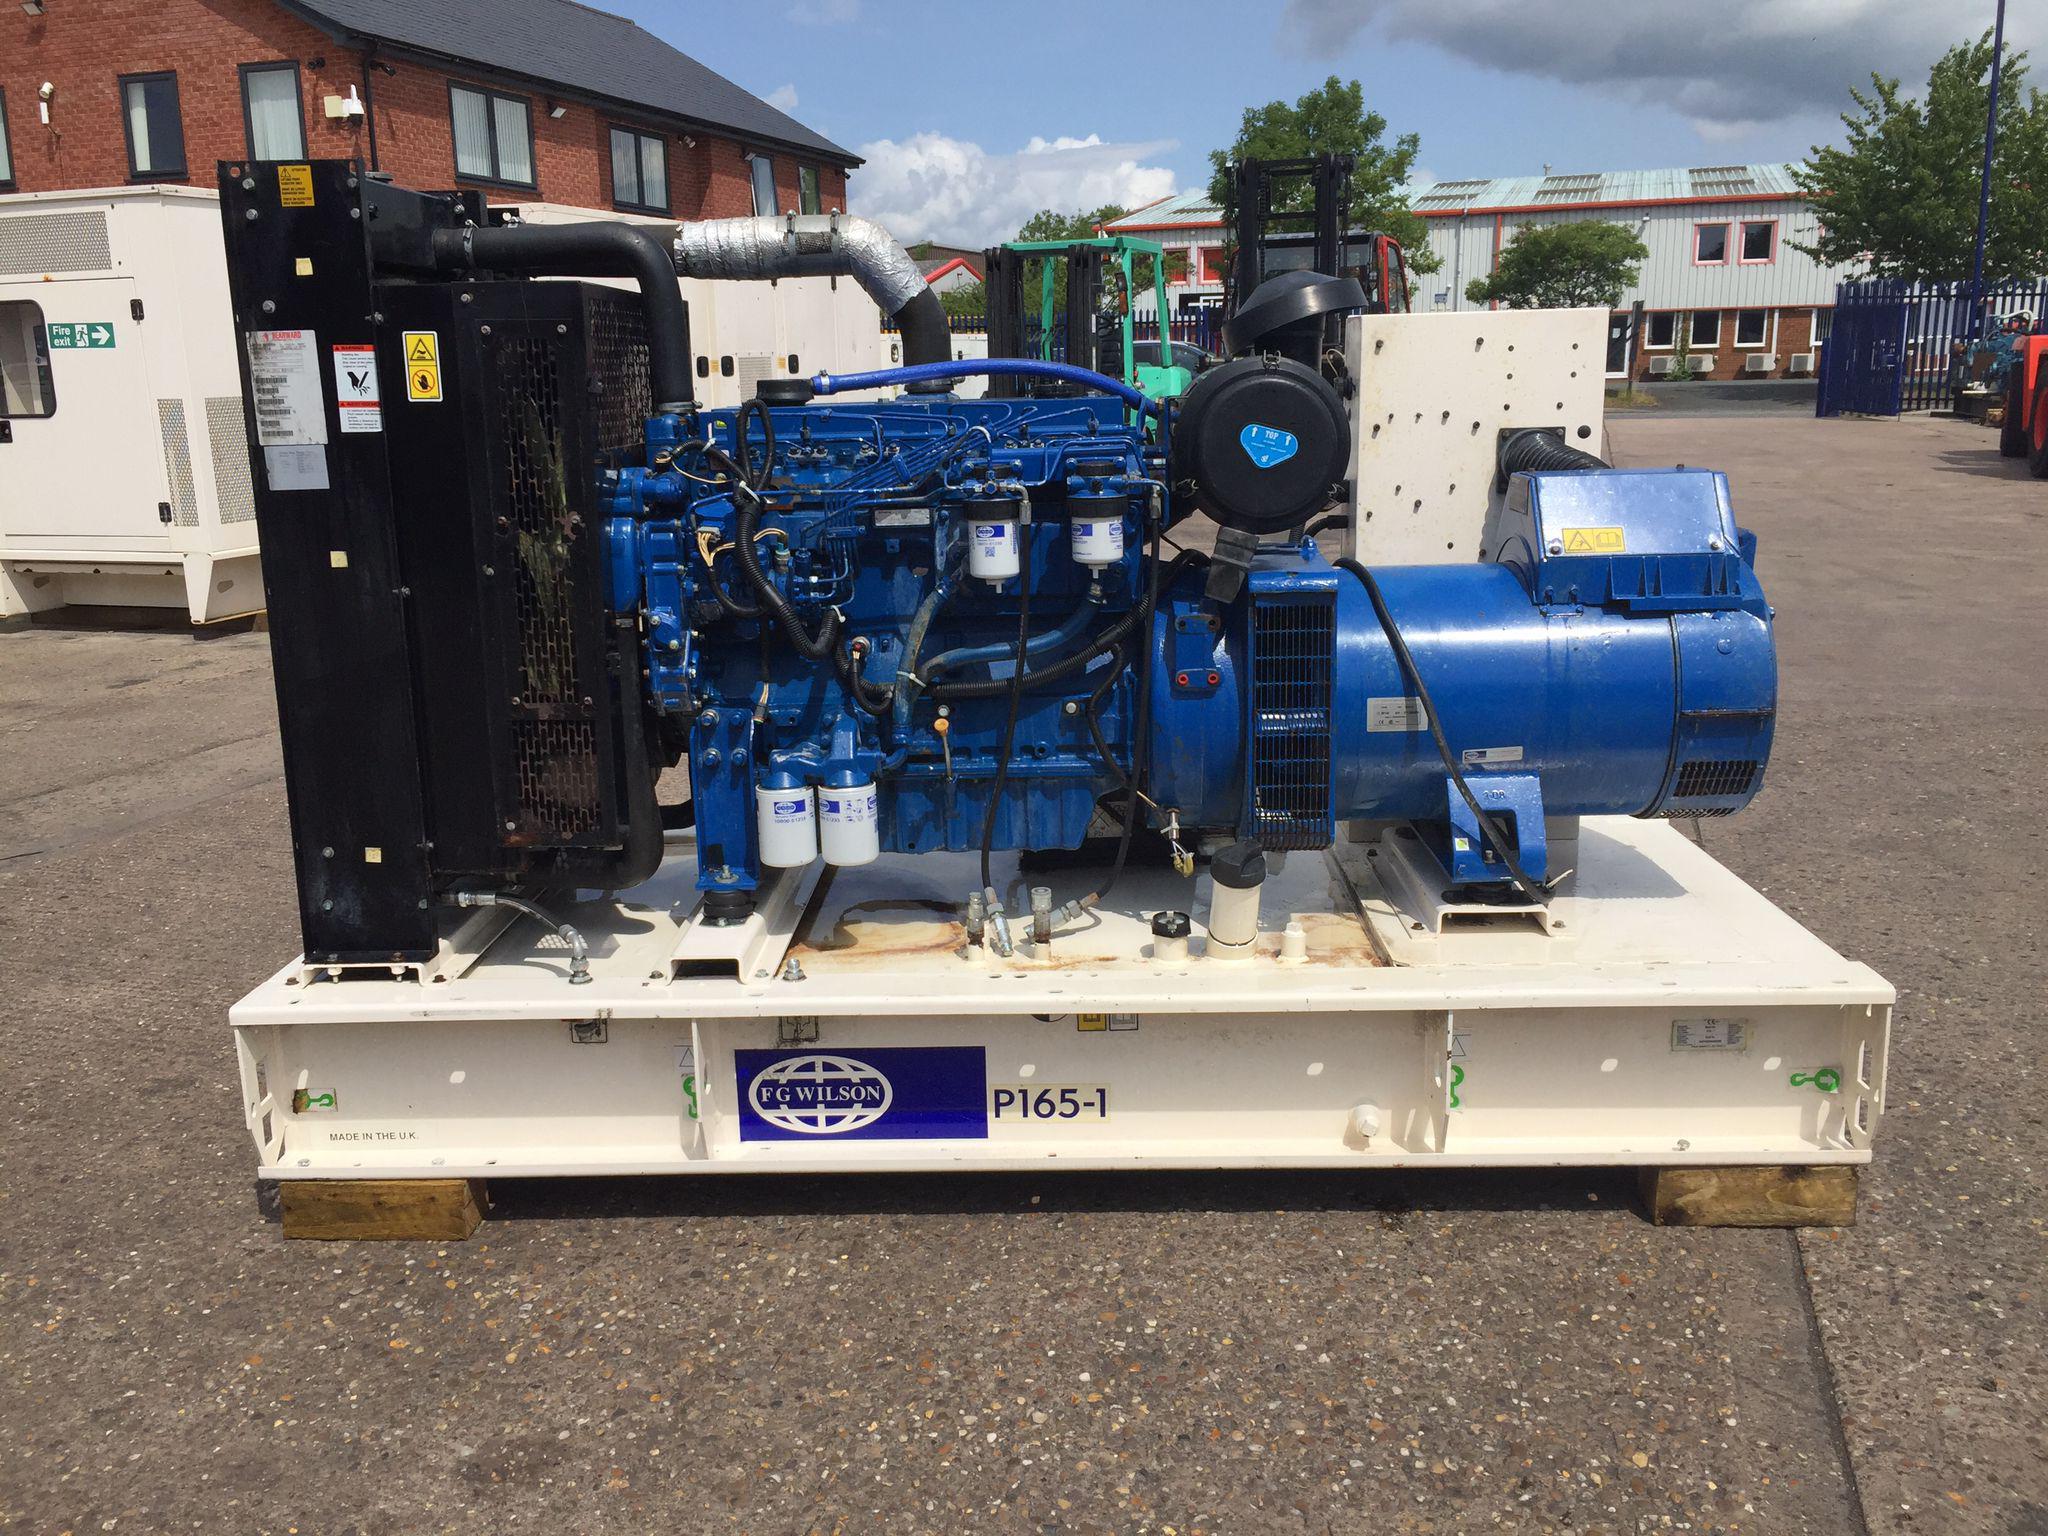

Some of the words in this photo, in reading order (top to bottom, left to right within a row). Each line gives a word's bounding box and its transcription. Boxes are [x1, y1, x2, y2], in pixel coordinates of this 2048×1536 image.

[52, 325, 71, 336] Fire
[53, 336, 71, 347] exit
[1265, 430, 1279, 440] TOP
[795, 1085, 881, 1101] WILSON
[994, 1088, 1106, 1119] P165-1
[329, 1132, 360, 1141] MADE
[362, 1132, 373, 1140] IN
[375, 1132, 396, 1140] THE
